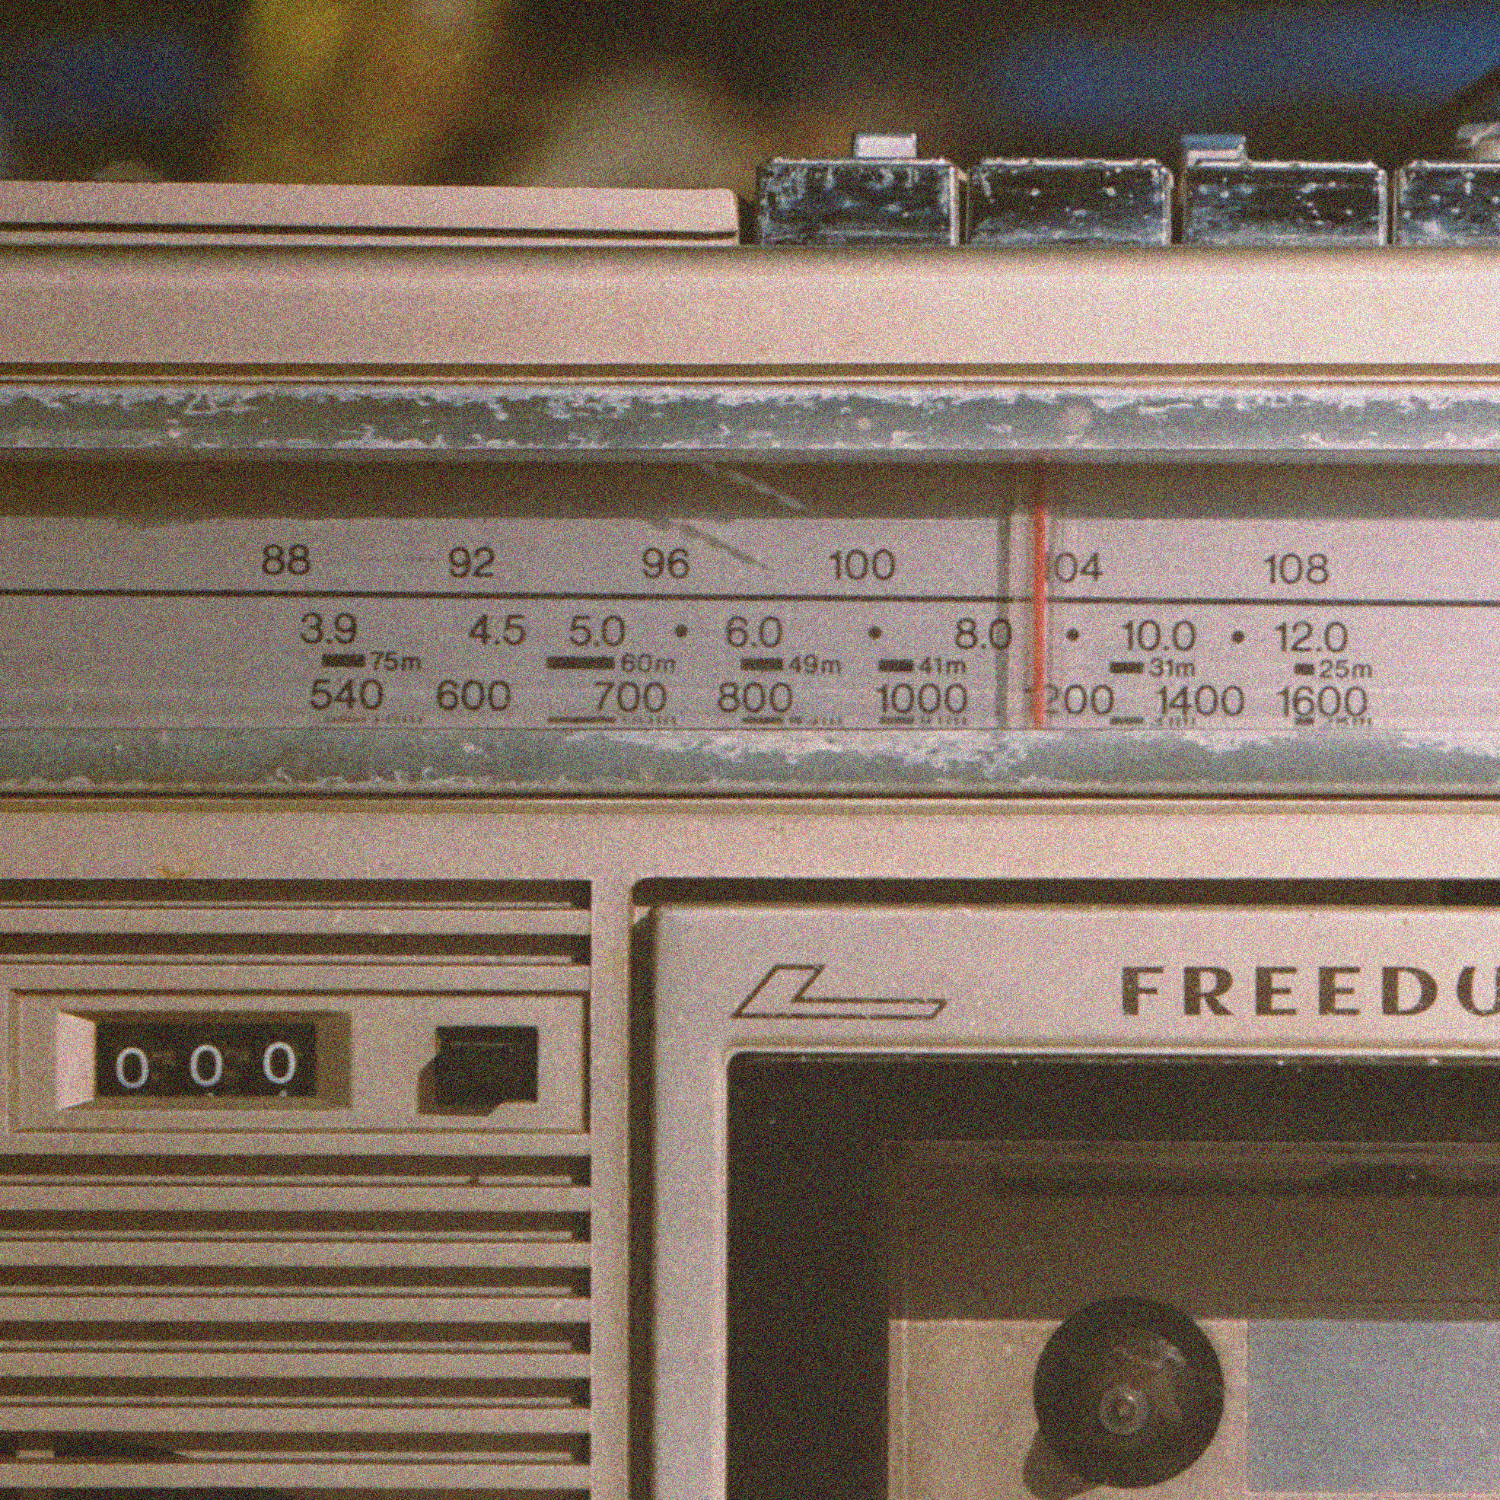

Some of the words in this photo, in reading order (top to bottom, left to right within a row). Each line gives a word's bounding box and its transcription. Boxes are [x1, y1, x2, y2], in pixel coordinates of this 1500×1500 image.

[261, 543, 313, 576] 88
[447, 545, 497, 579] 92
[641, 546, 692, 580] 96
[828, 547, 897, 582] 100
[1263, 552, 1331, 585] 108
[299, 611, 358, 645] 3.9
[468, 613, 527, 647] 4.5
[568, 614, 627, 647] 5.0
[724, 614, 784, 649] 6.0
[954, 616, 1013, 650] 8.0
[1121, 619, 1198, 653] 10.0
[1273, 620, 1349, 653] 12.0
[370, 650, 423, 672] 75m
[620, 652, 677, 675] 60m
[788, 653, 843, 676] 49m
[919, 656, 968, 676] 41m
[1149, 658, 1197, 678] 31m
[1318, 659, 1375, 679] 25m
[309, 678, 385, 712] 540
[435, 679, 513, 713] 600
[593, 680, 668, 713] 700
[716, 681, 794, 714] 800
[875, 682, 969, 715] 1000
[1156, 684, 1246, 717] 1400
[1277, 685, 1369, 718] 1600
